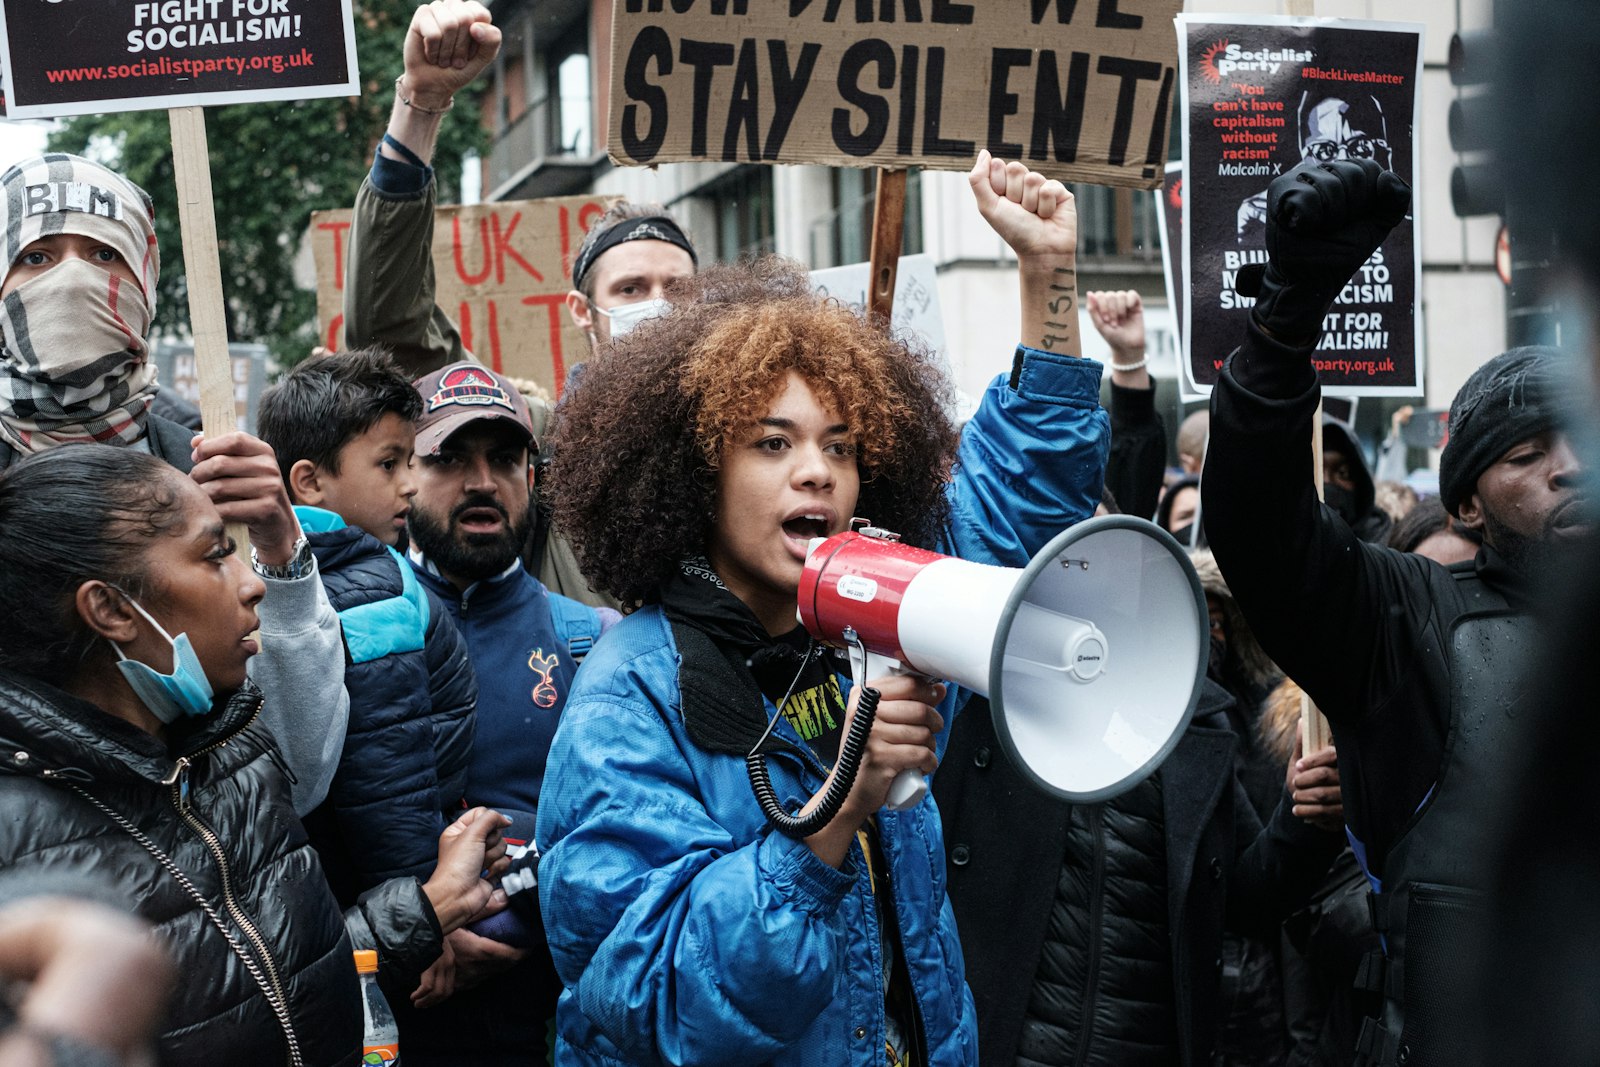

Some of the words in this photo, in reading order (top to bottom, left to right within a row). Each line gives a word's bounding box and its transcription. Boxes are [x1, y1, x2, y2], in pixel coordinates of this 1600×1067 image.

[134, 0, 223, 27] FIGHT
[232, 0, 290, 18] FOR
[127, 14, 302, 53] SOCIALISM!
[1224, 43, 1313, 62] Socialist
[46, 48, 314, 83] www.socialistparty.org.uk
[1302, 67, 1404, 85] #BlackLivesMatter
[1231, 83, 1265, 95] "You
[621, 26, 822, 163] STAY
[832, 38, 1174, 178] SILENT!
[1213, 98, 1248, 111] can't
[1251, 98, 1284, 111] have
[1213, 114, 1285, 131] capitalism
[1221, 129, 1278, 143] without
[1223, 146, 1276, 160] racism"
[1218, 161, 1270, 176] Malcolm
[1273, 163, 1282, 175] X
[25, 183, 117, 218] BLM
[452, 211, 544, 285] UK
[1359, 264, 1390, 284] TO
[1334, 284, 1393, 304] CISM
[1344, 312, 1383, 331] FOR
[1315, 331, 1389, 350] ALISM!
